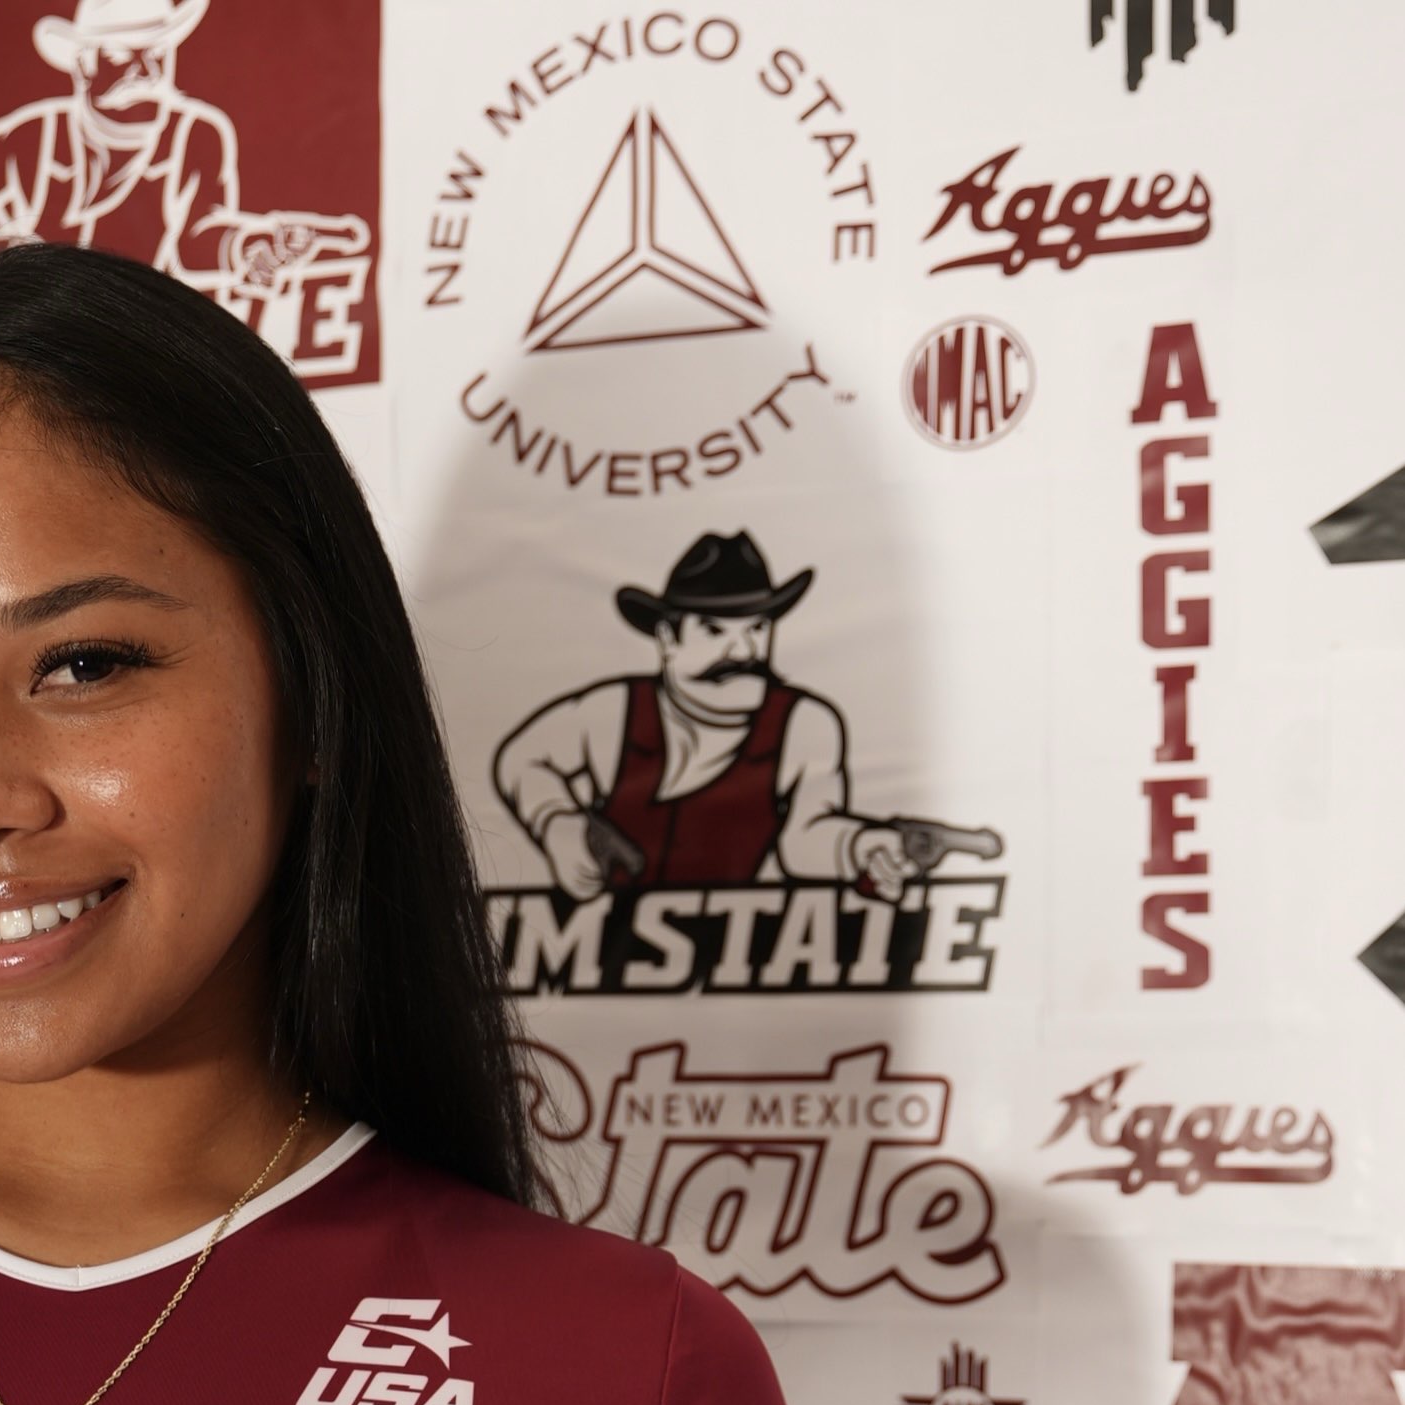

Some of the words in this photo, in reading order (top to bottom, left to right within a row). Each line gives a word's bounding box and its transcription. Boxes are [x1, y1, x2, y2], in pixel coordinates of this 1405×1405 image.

[426, 150, 486, 308] NEW
[484, 12, 741, 138] MEXICO
[758, 47, 878, 264] STATE
[919, 143, 1212, 278] Aggies
[459, 343, 830, 497] UNIVERSITY
[1128, 321, 1220, 992] AGGIES
[488, 886, 616, 994] M
[619, 875, 1007, 994] STATE
[624, 1093, 727, 1129] NEW
[744, 1093, 933, 1130] MEXICO
[1037, 1062, 1334, 1195] Aggies
